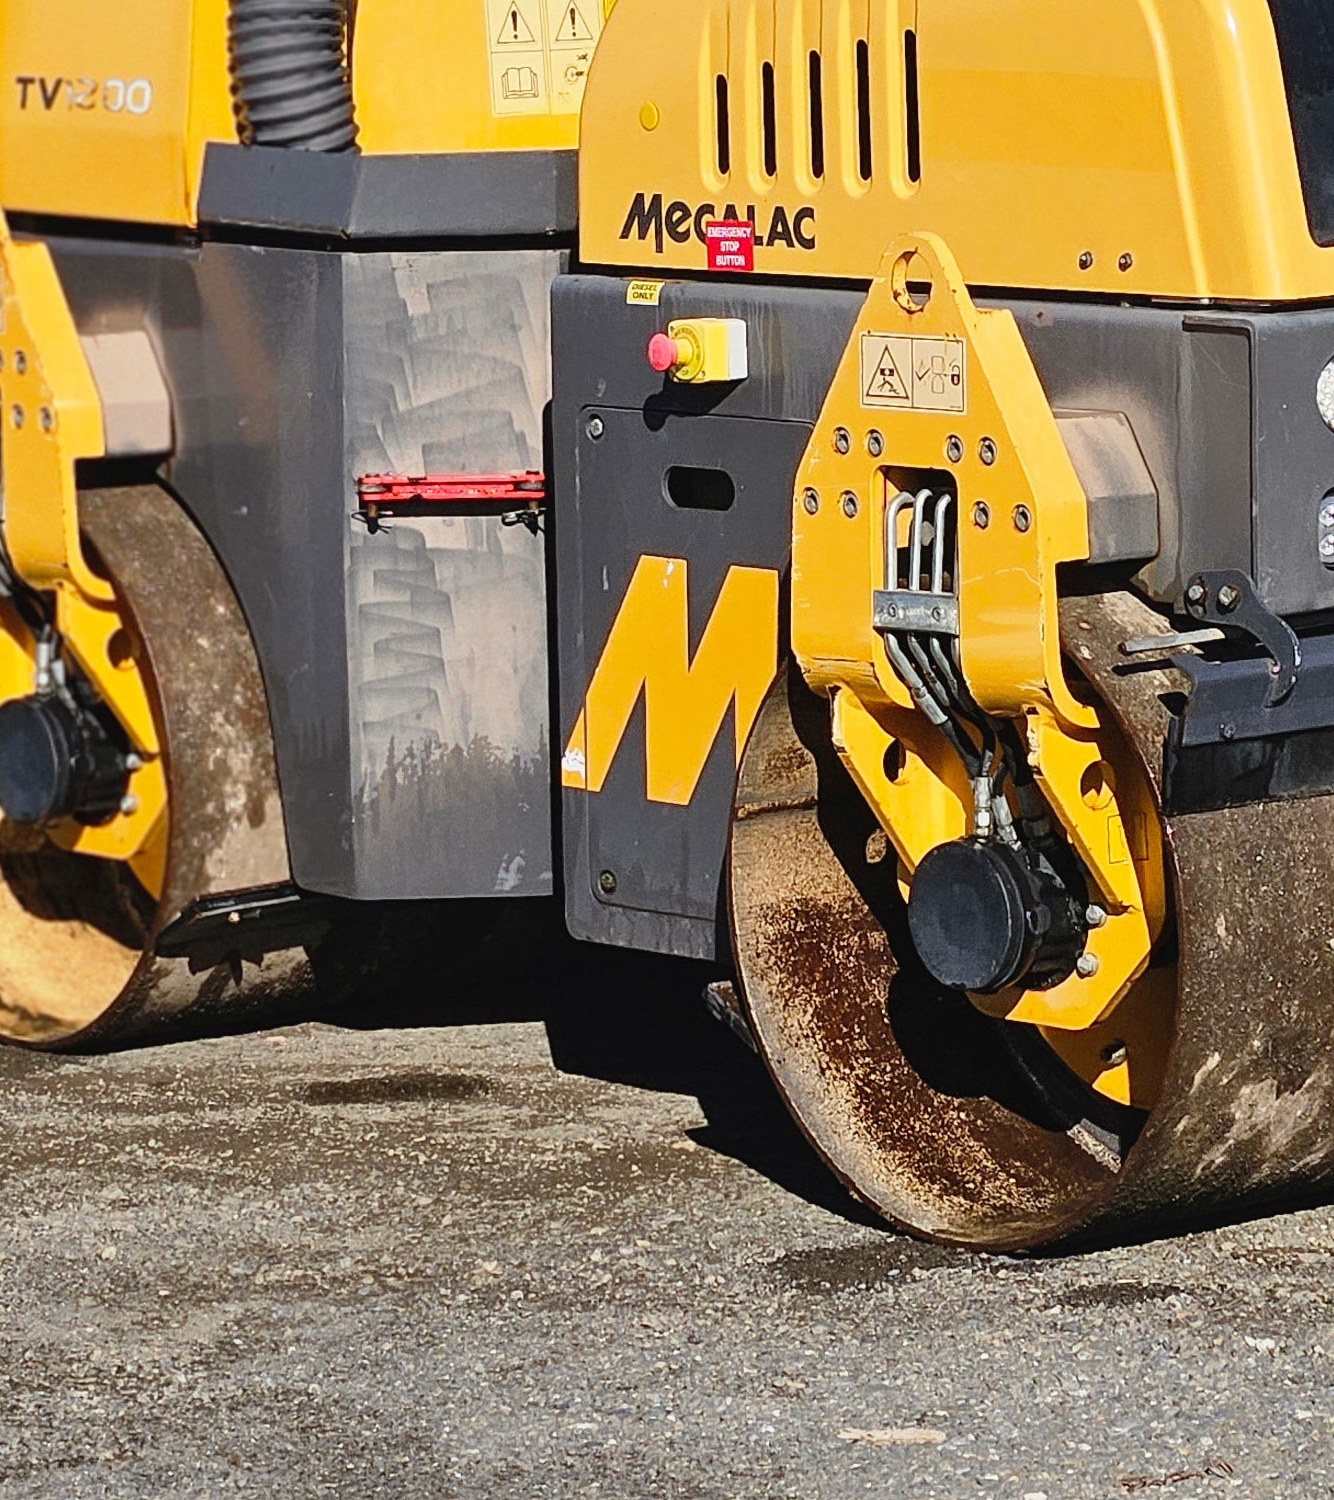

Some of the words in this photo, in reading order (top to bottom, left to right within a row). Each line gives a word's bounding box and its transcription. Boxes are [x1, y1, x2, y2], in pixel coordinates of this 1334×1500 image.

[707, 226, 752, 238] EMERGENCY
[720, 240, 740, 252] STOP
[715, 254, 746, 267] BUTTON
[632, 283, 658, 291] DIESEL
[632, 291, 655, 300] ONLY
